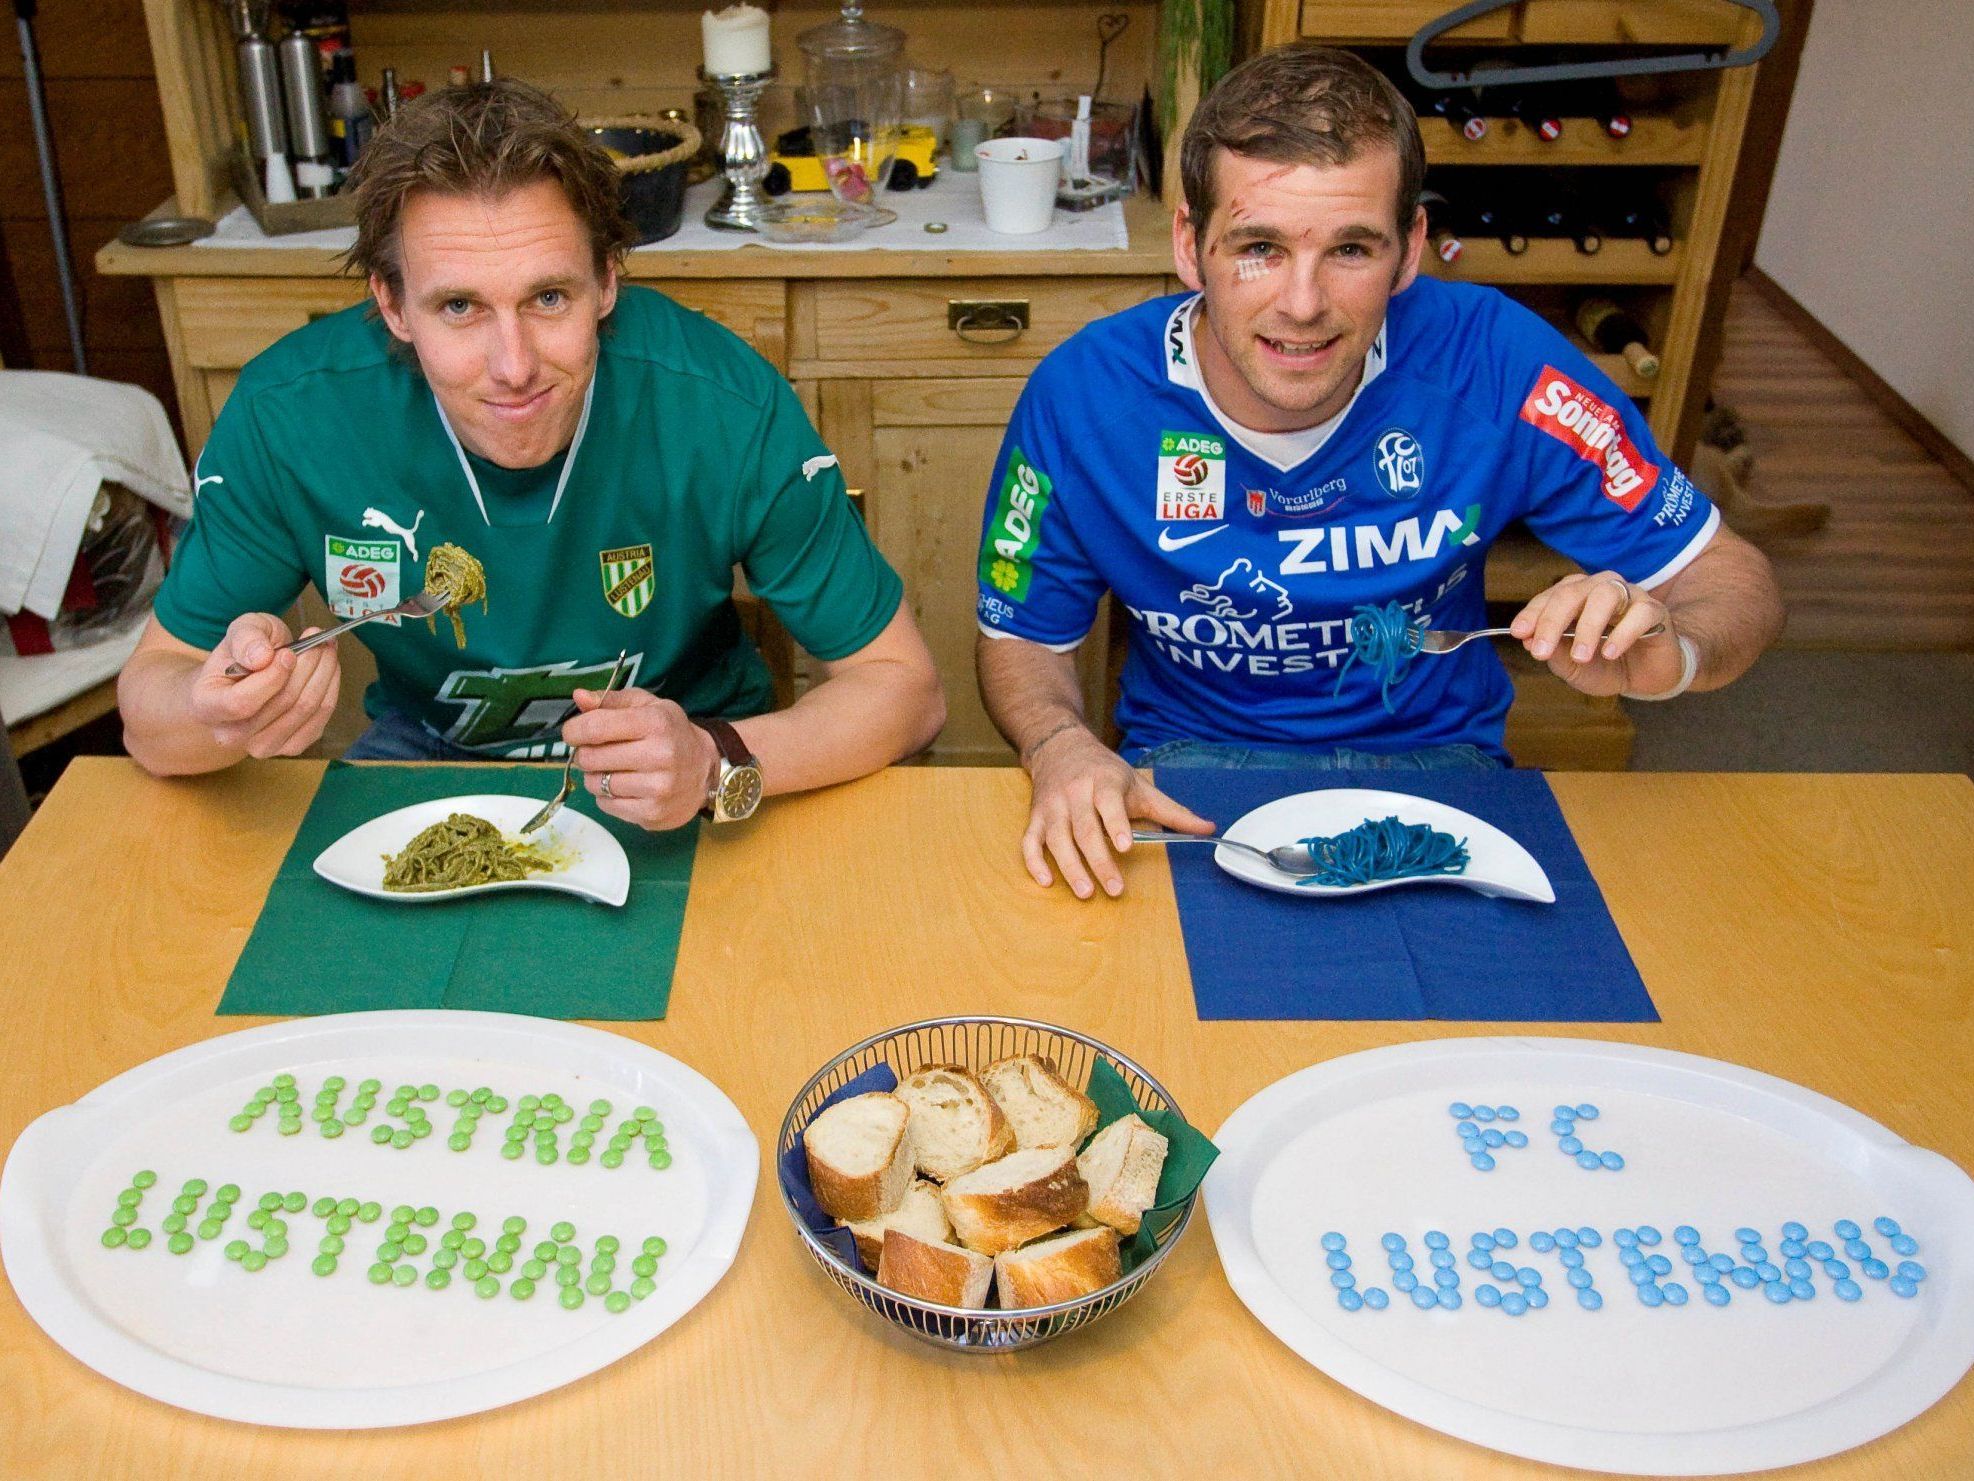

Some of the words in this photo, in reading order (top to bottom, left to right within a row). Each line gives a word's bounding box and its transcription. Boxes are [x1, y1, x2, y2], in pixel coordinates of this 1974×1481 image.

[1176, 438, 1224, 455] ADEG
[1534, 380, 1644, 497] Sonntag
[994, 463, 1040, 563] ADEG
[1162, 503, 1218, 519] LIGA
[1163, 492, 1217, 503] ERSTE
[1269, 477, 1347, 506] Vorarlberg
[345, 544, 394, 560] ADEG
[607, 548, 645, 561] AUSTRIA
[1278, 503, 1482, 576] ZIMA
[230, 1073, 674, 1170] AUSTRIA
[101, 1169, 669, 1314] LUSTENAU
[1321, 1215, 1928, 1317] LUSTENAU
